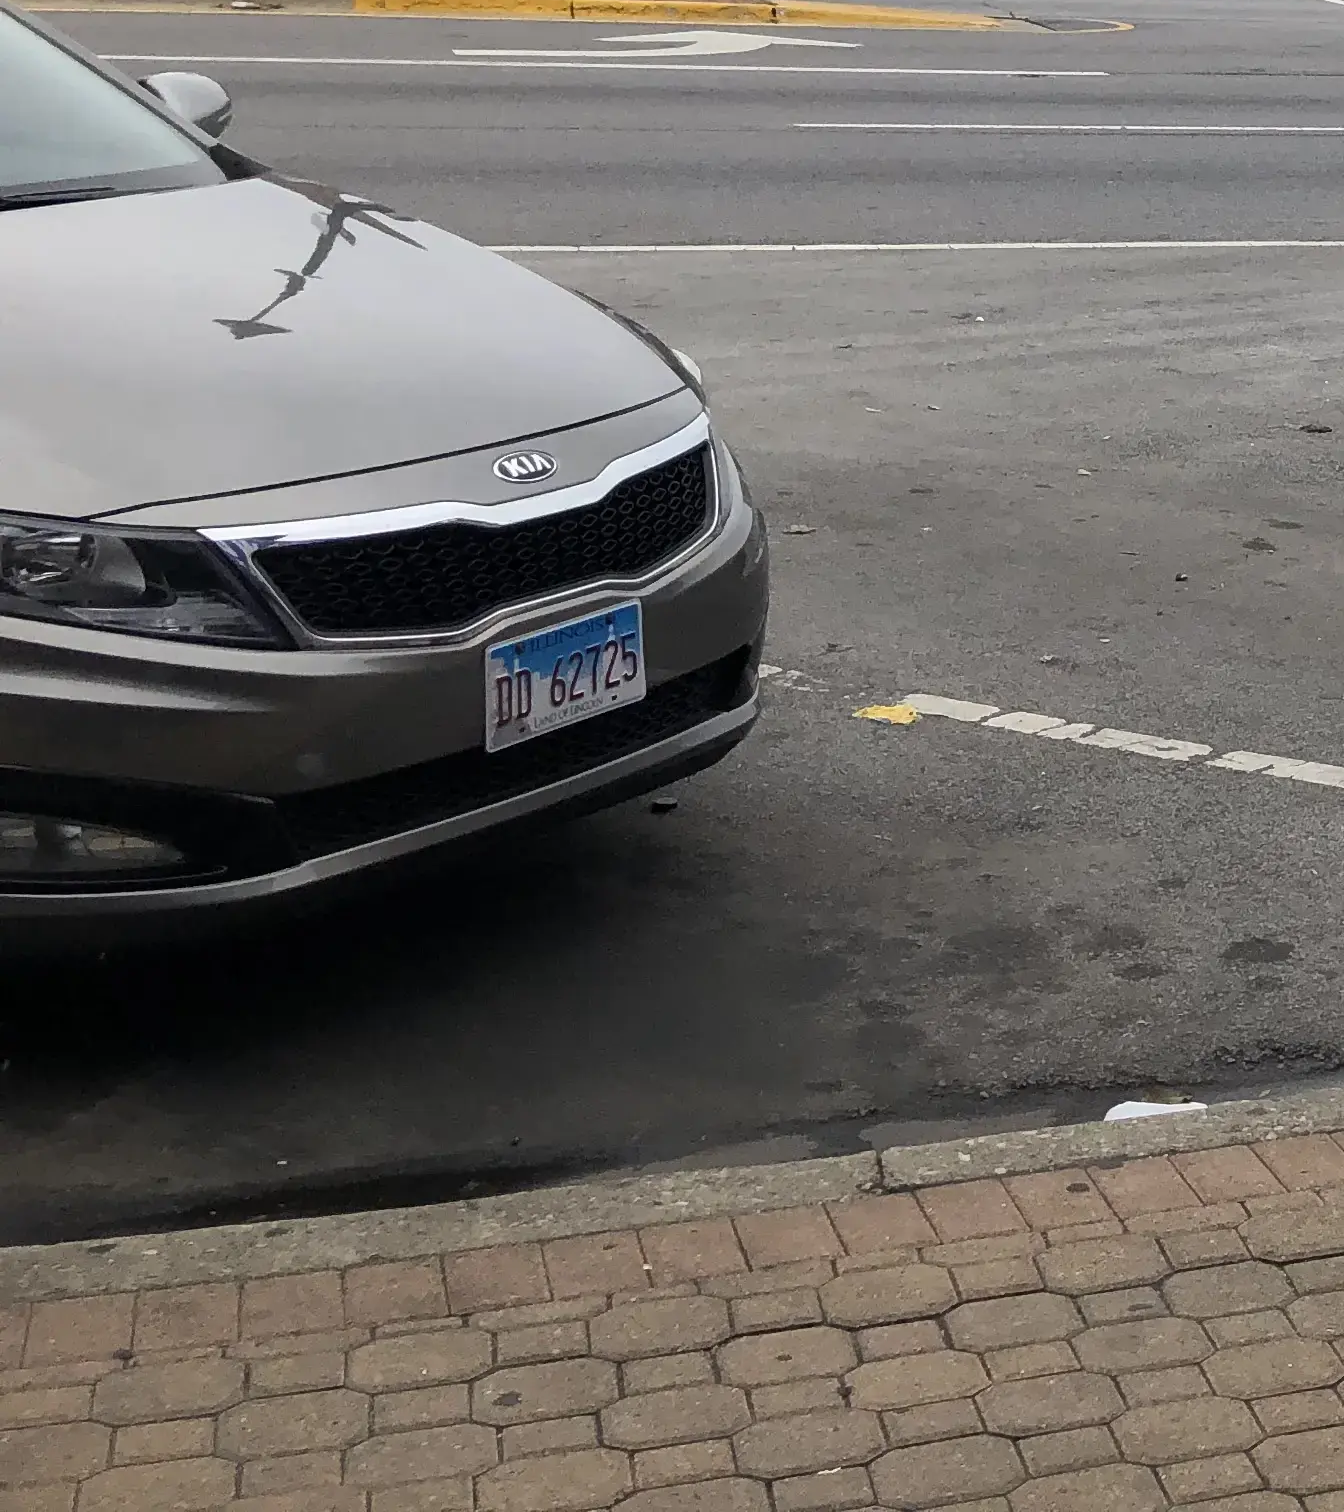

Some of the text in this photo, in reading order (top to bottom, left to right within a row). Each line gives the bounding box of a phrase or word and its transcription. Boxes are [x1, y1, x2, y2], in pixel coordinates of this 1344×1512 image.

[503, 453, 552, 478] KIA
[529, 617, 605, 652] ILLINOIS
[496, 630, 639, 729] DD 62725
